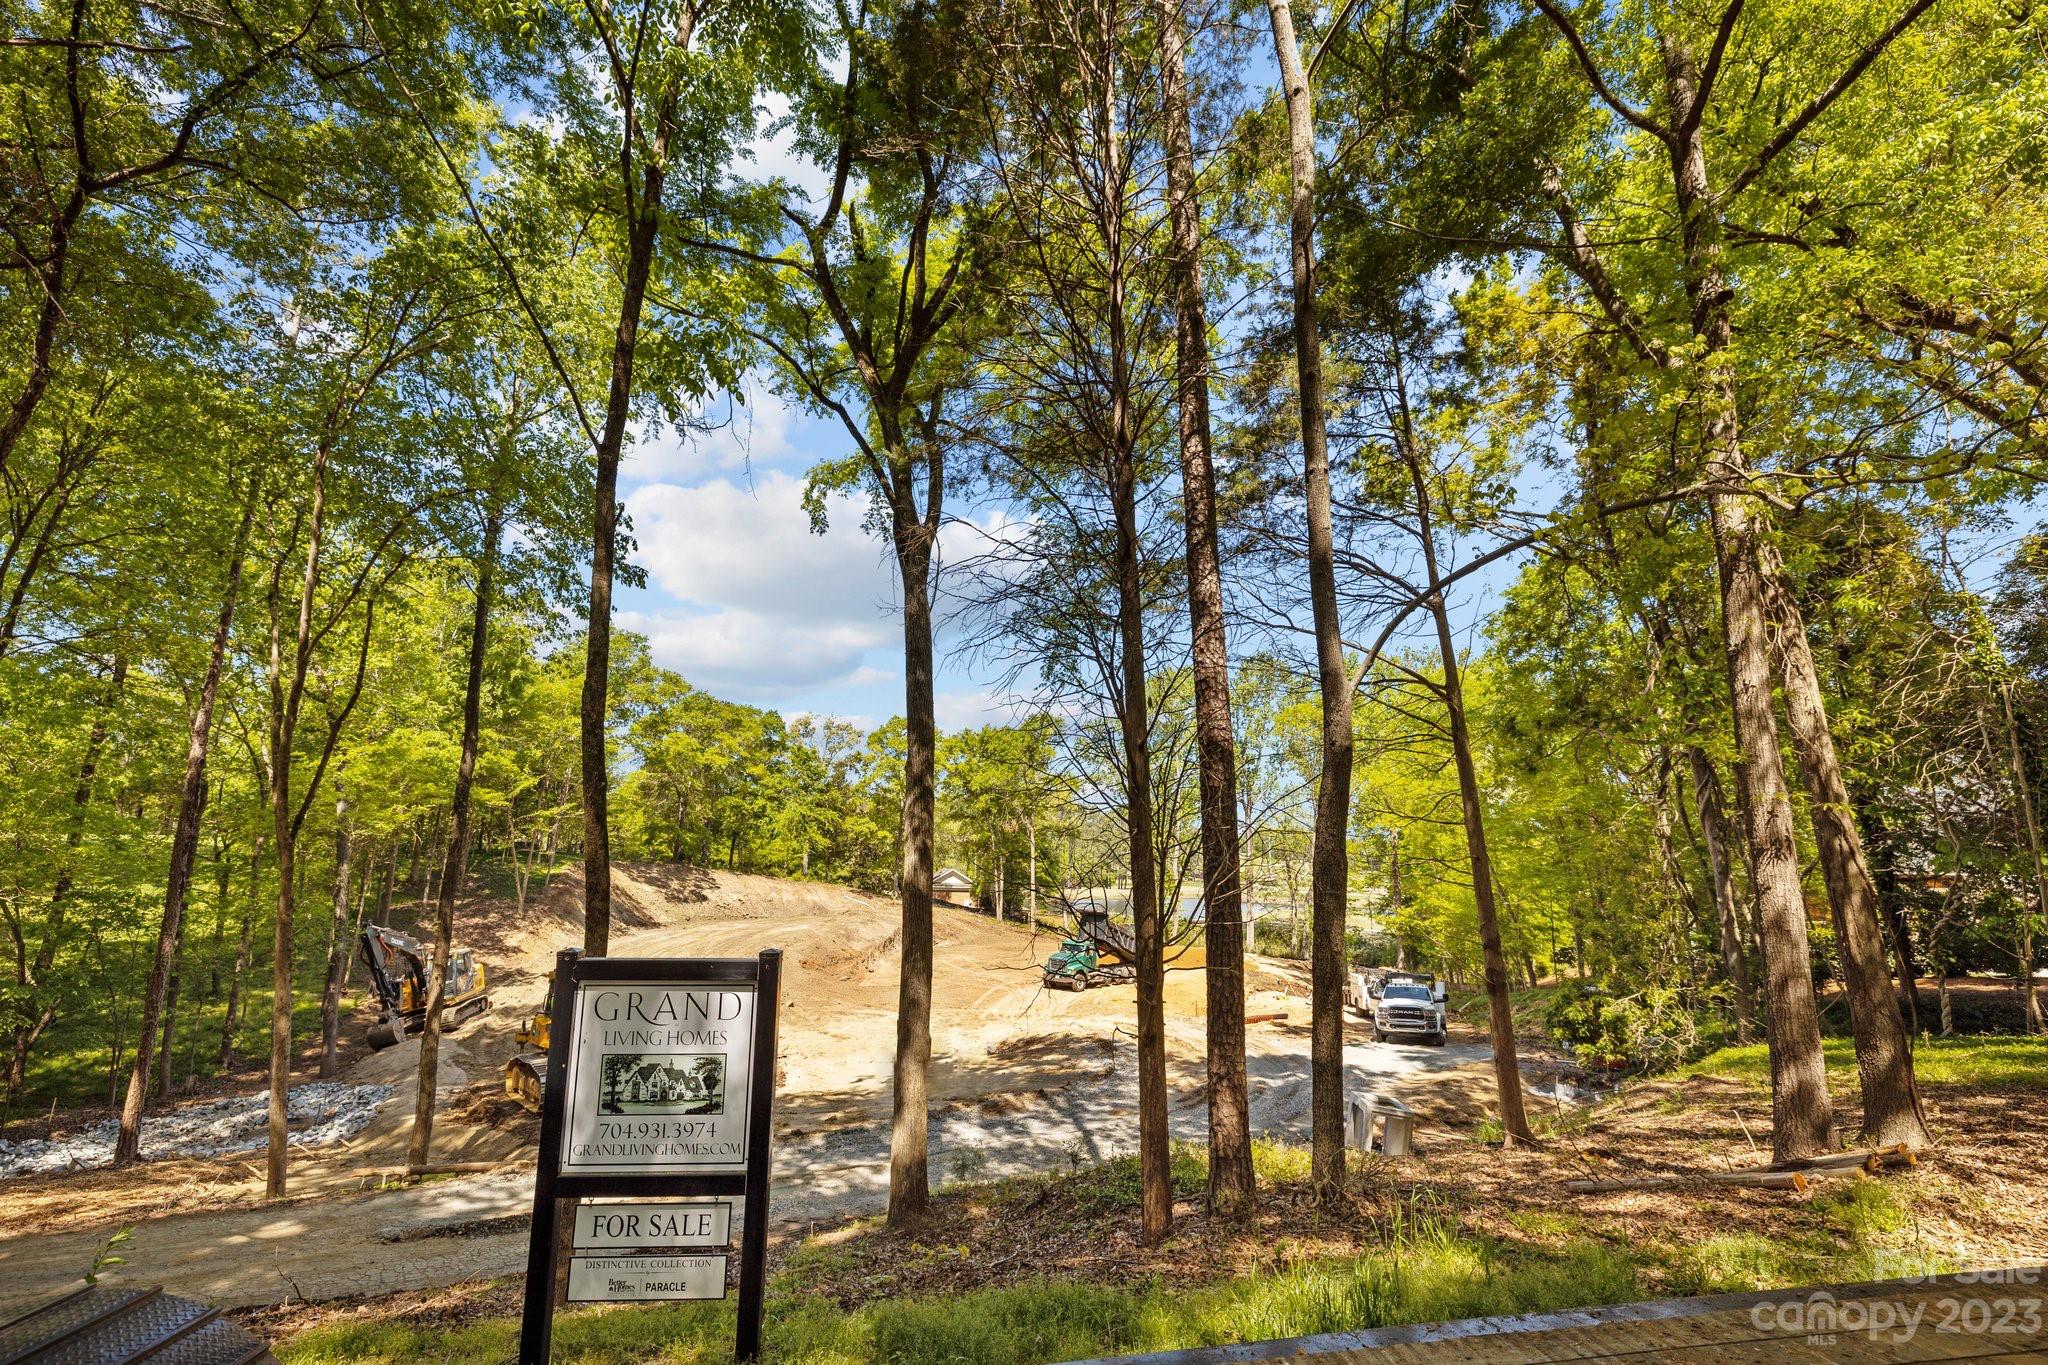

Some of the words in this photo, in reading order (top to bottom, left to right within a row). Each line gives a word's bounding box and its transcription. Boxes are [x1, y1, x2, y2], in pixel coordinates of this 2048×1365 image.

[594, 992, 742, 1026] GRAND
[604, 1030, 662, 1046] LIVING
[666, 1030, 728, 1046] HOMES
[600, 1122, 716, 1139] 704.931.3974
[572, 1143, 741, 1156] GRANDLIVINGHOMES.COM
[592, 1214, 641, 1238] FOR
[649, 1213, 712, 1237] SALE
[585, 1260, 647, 1269] DISTINCTIVE
[650, 1259, 712, 1268] COLLECTION
[645, 1282, 687, 1292] PARACLE
